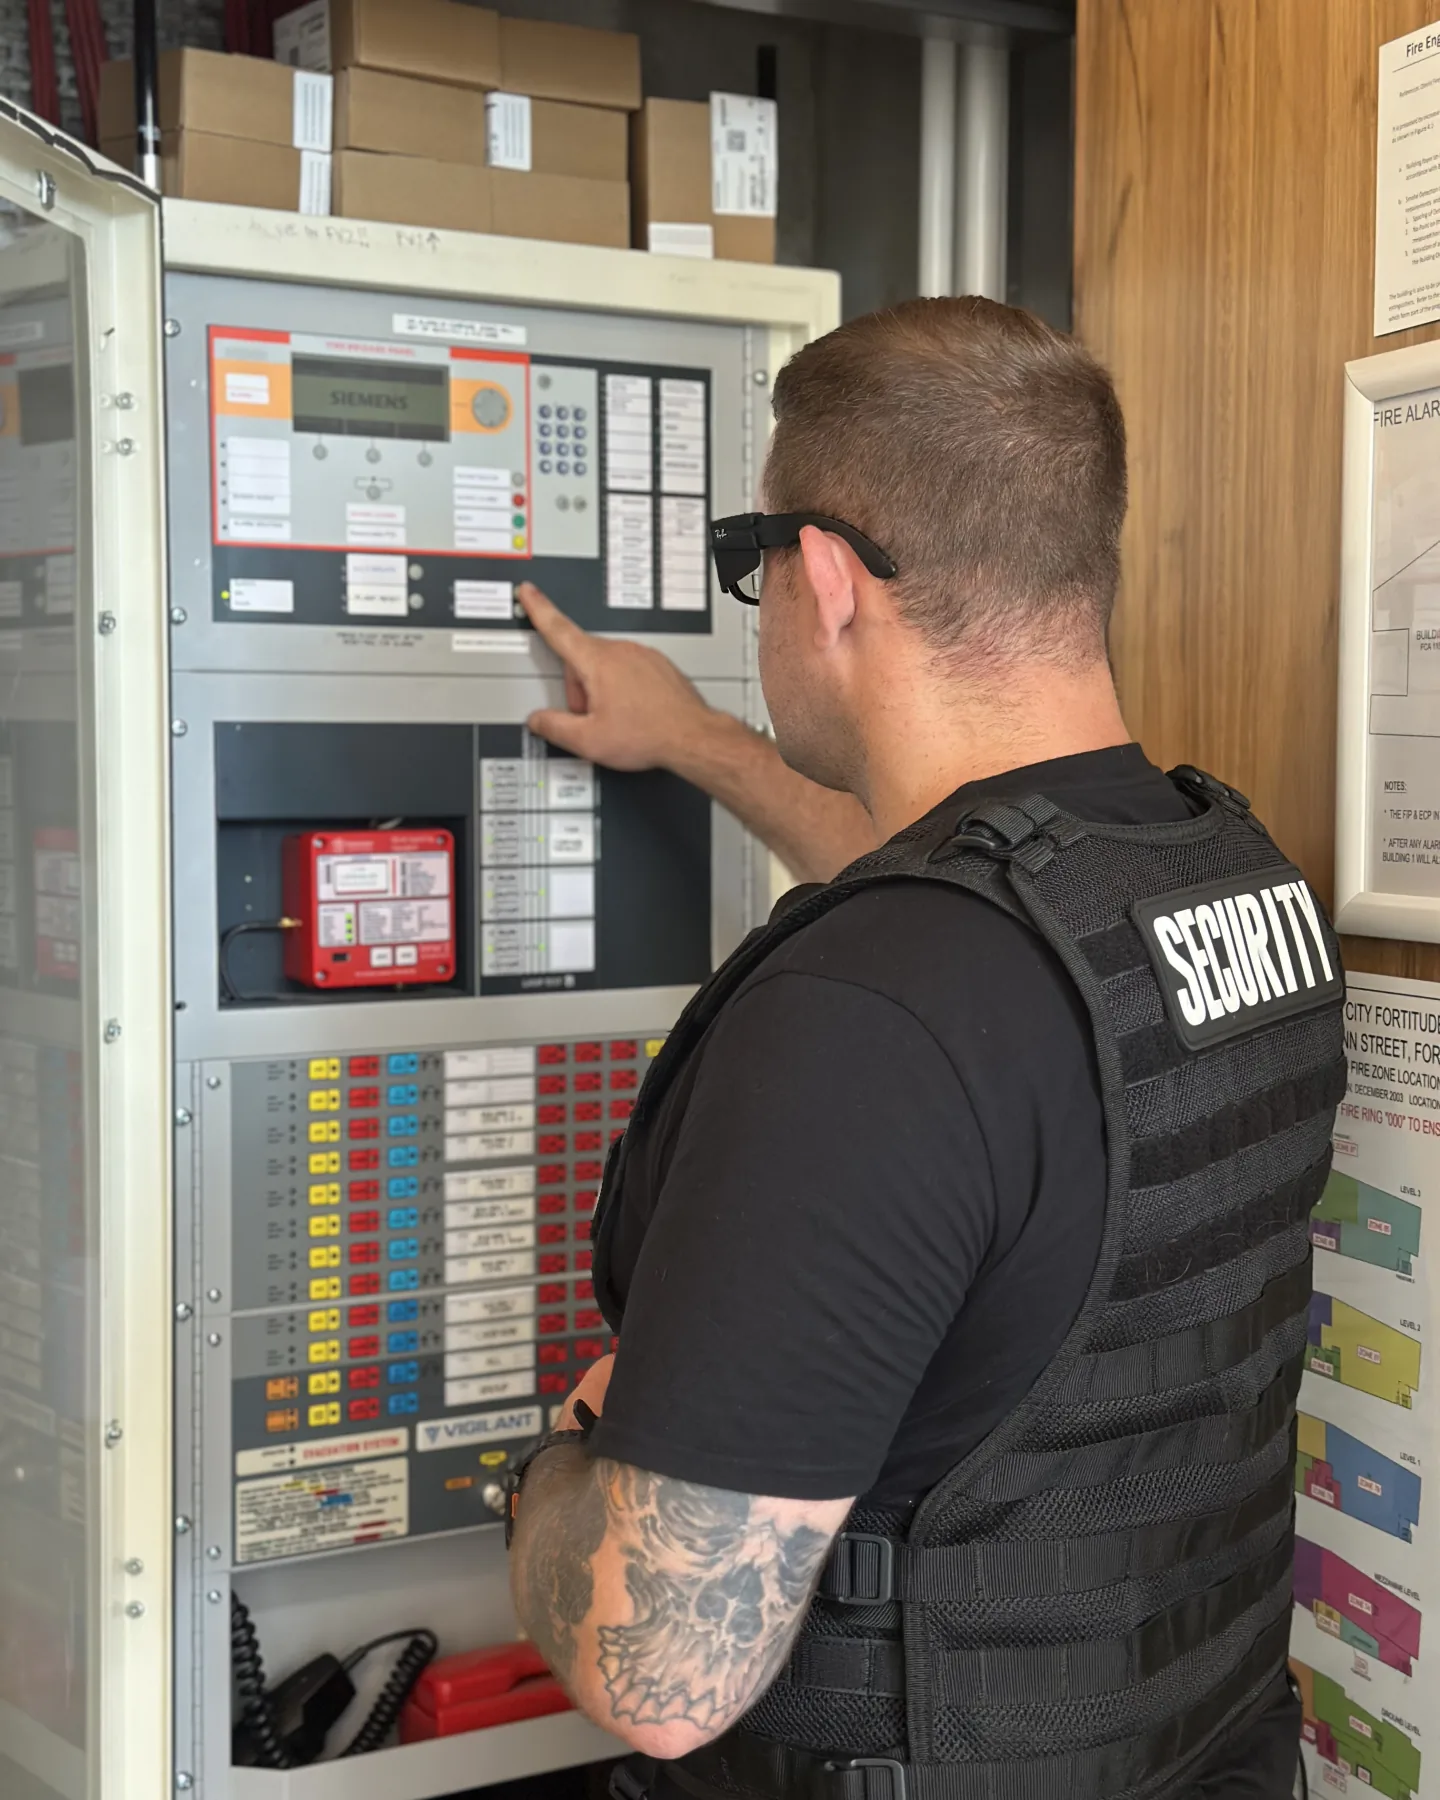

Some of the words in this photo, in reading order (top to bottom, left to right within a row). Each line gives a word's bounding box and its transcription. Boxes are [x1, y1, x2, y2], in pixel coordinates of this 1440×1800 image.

[1406, 42, 1423, 58] Fire
[331, 389, 409, 412] SIEMENS
[1374, 407, 1402, 428] FIRE
[1416, 629, 1440, 641] BUILD
[1384, 780, 1407, 791] NOTES:
[1389, 809, 1402, 819] THE
[1388, 837, 1408, 848] AFTER
[1408, 838, 1422, 849] ANY
[1382, 851, 1410, 863] BUILDING
[1416, 854, 1430, 864] WILL
[1153, 879, 1334, 1027] SECURITY
[1346, 1002, 1372, 1023] CITY
[1361, 1033, 1411, 1063] STREET,
[1415, 1042, 1440, 1066] FOR
[1351, 1060, 1370, 1078] FIRE
[1372, 1064, 1396, 1083] ZONE
[1355, 1084, 1389, 1101] DECEMBER
[1389, 1091, 1404, 1103] 2003
[1340, 1102, 1360, 1119] FIRE
[1362, 1106, 1383, 1124] RING
[1385, 1112, 1406, 1129] "000"
[1408, 1116, 1421, 1132] TO
[1400, 1185, 1417, 1197] LEVEL
[1400, 1319, 1416, 1331] LEVEL
[443, 1411, 534, 1438] VIGILANT
[1400, 1452, 1416, 1465] LEVEL
